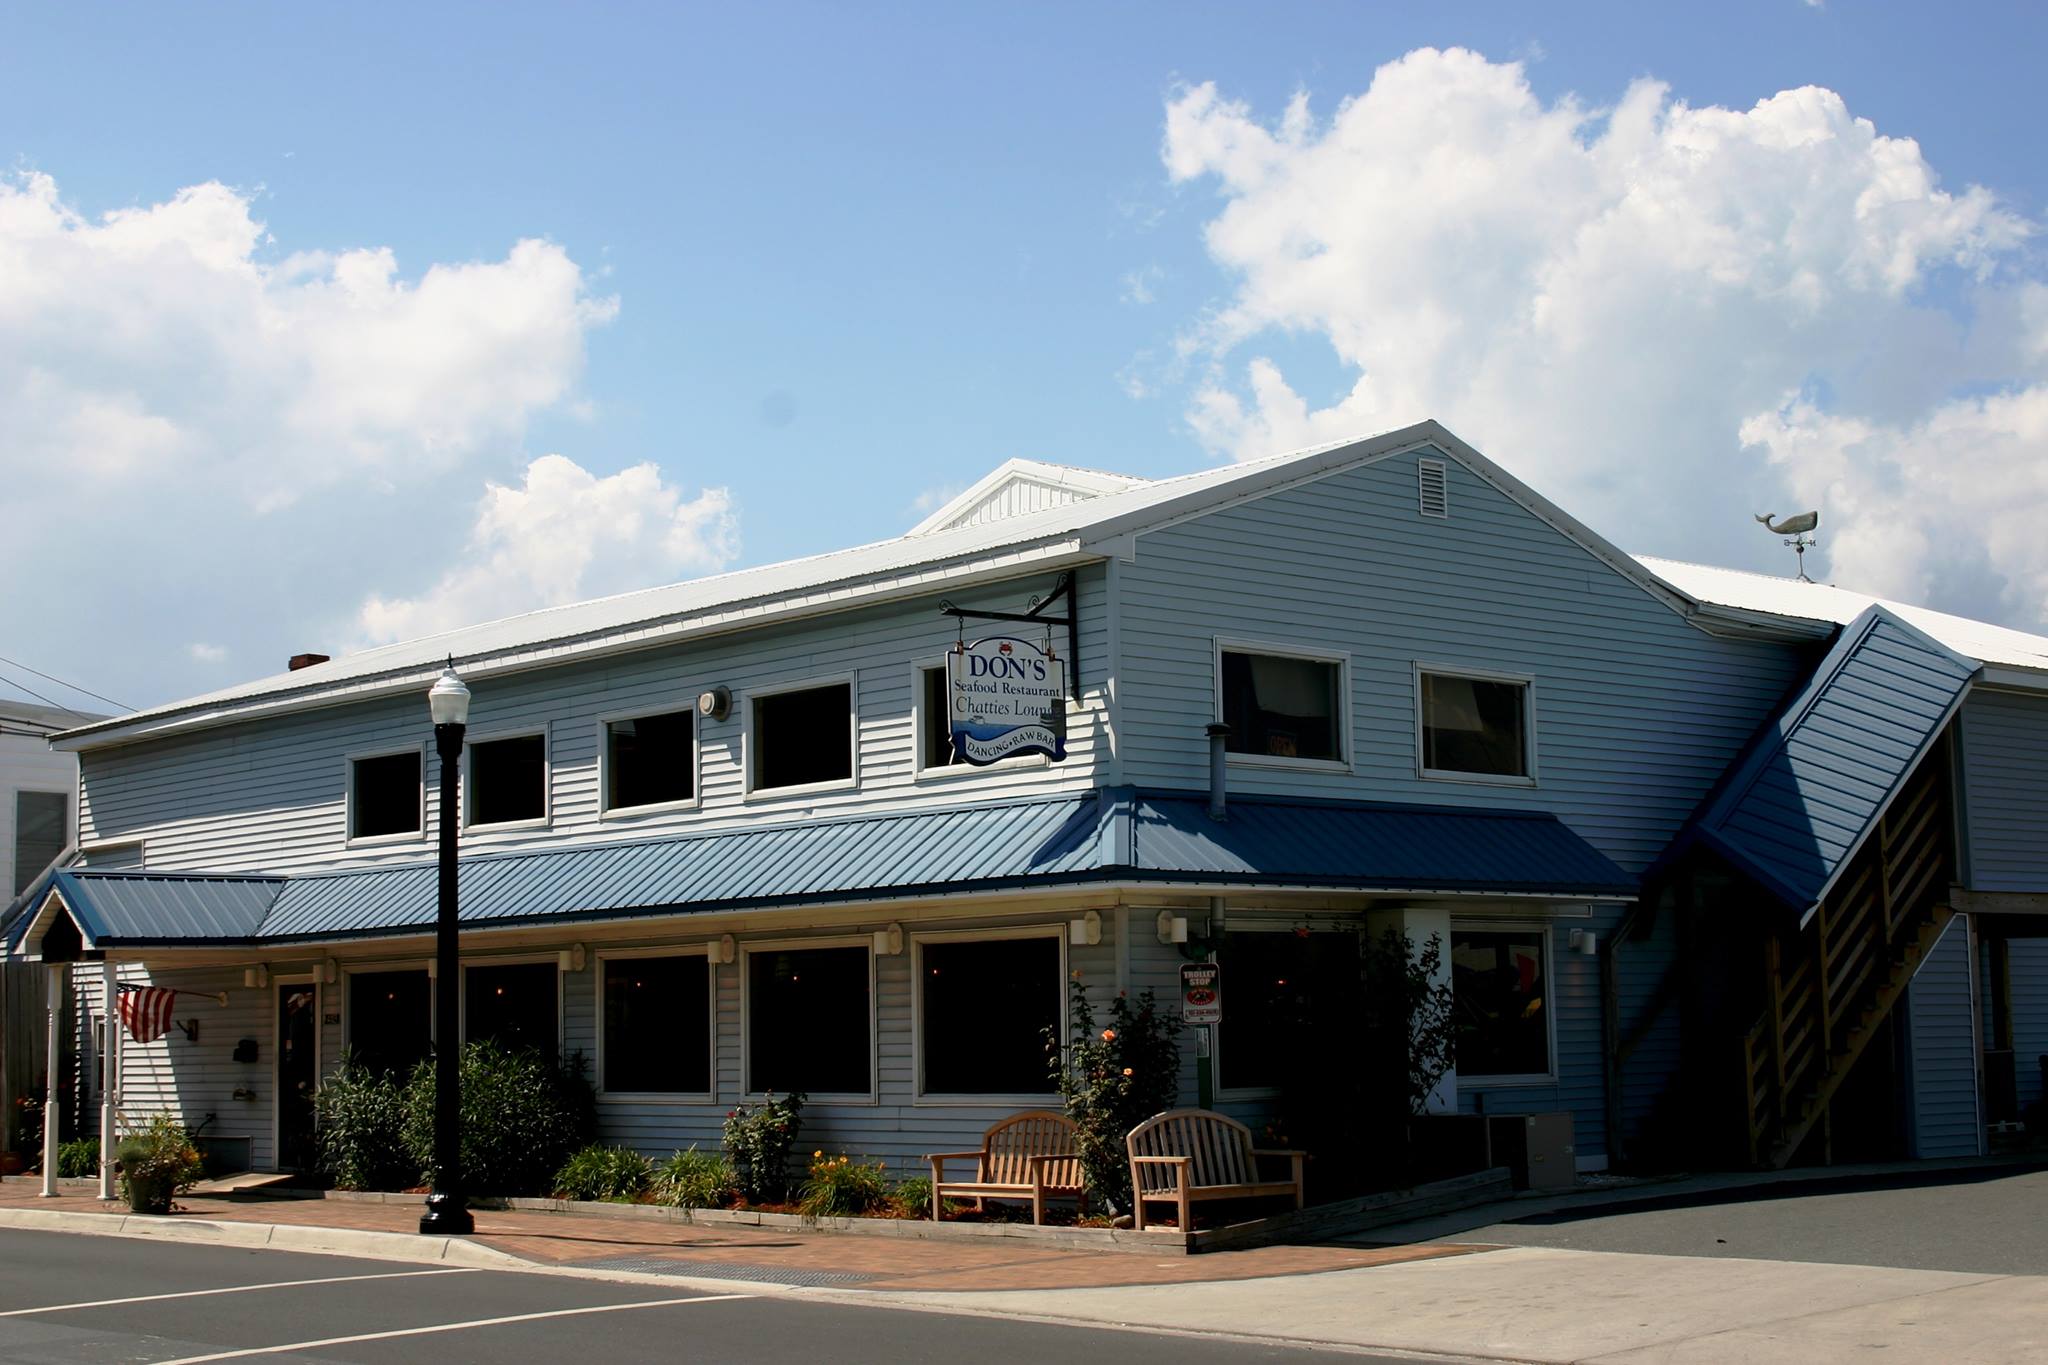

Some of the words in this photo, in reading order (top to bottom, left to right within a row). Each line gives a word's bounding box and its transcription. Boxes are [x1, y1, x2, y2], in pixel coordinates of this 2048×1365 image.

[969, 655, 1046, 681] DON'S
[954, 679, 997, 694] Seafood
[1002, 683, 1060, 697] Restaurant
[956, 696, 1009, 715] Chatties
[1015, 700, 1060, 718] Loung
[967, 741, 1009, 757] DANCING
[1012, 731, 1035, 747] RAW
[1037, 731, 1055, 747] BAR
[1183, 970, 1216, 978] TROLLEY
[1189, 978, 1211, 986] STOP
